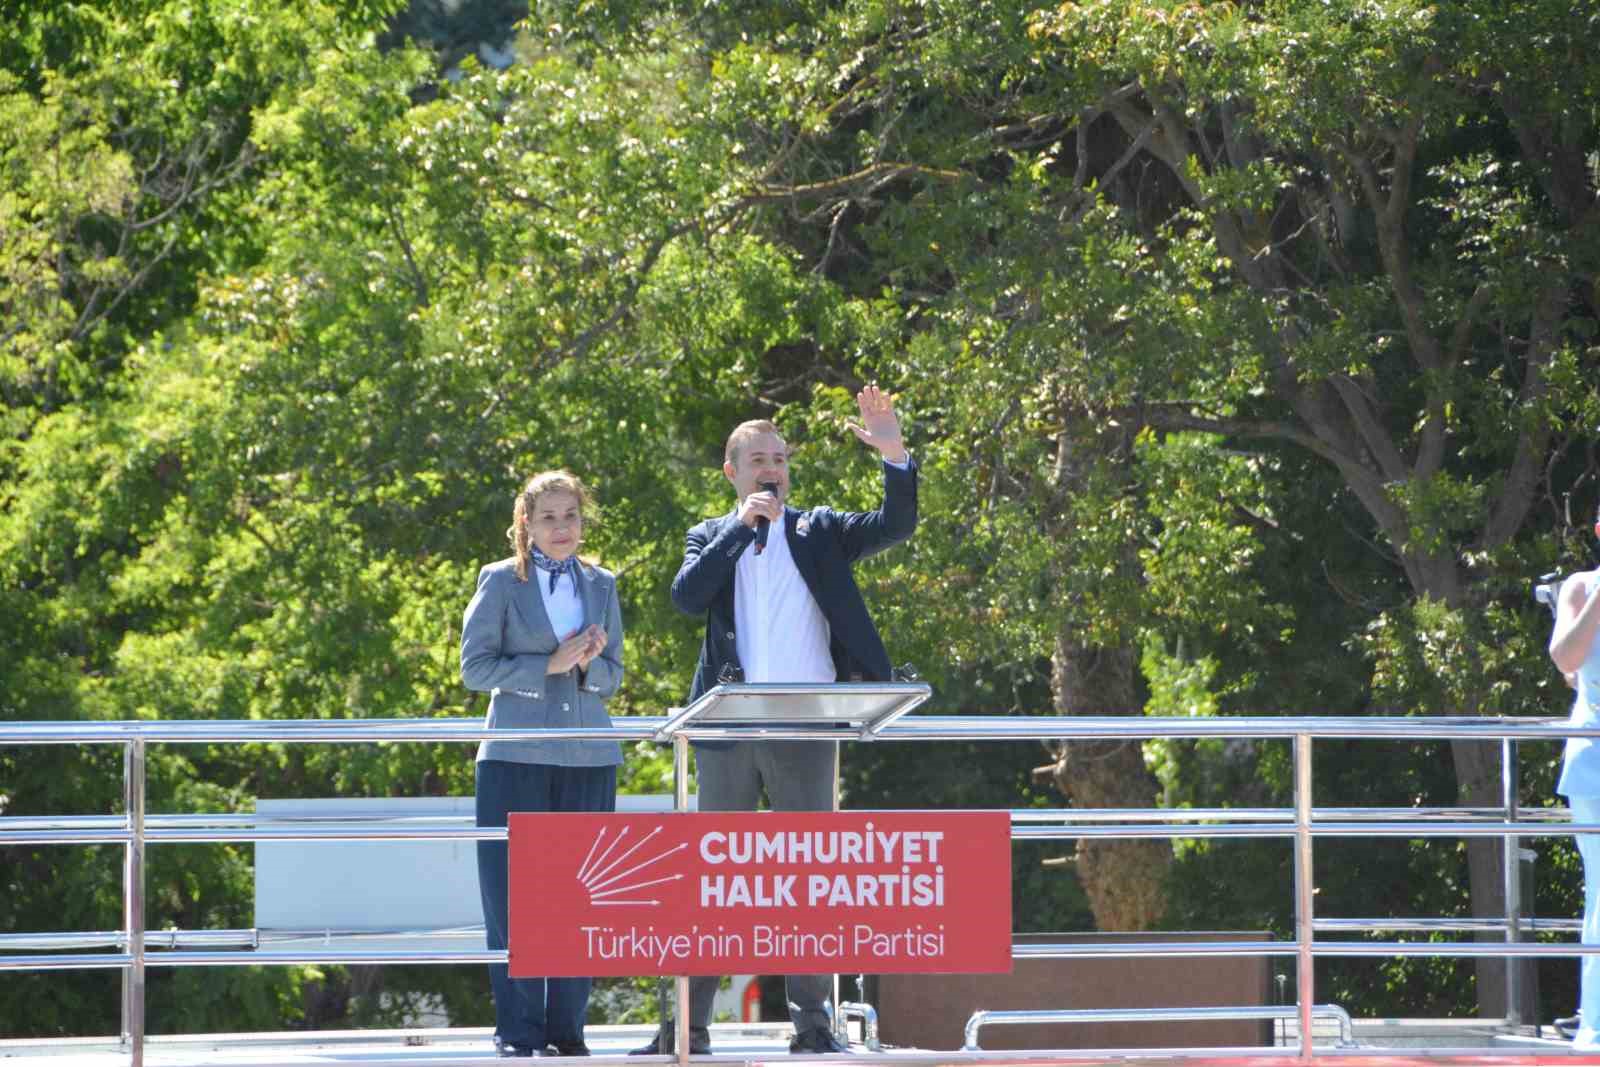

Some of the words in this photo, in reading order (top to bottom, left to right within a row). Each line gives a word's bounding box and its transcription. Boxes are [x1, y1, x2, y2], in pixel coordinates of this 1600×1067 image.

[700, 821, 945, 864] CUMHURİYET
[700, 875, 798, 907] HALK
[808, 865, 944, 907] PARTİSİ
[581, 925, 743, 967] Türkiye'nin
[754, 925, 843, 957] Birinci
[854, 925, 945, 957] Partisi
